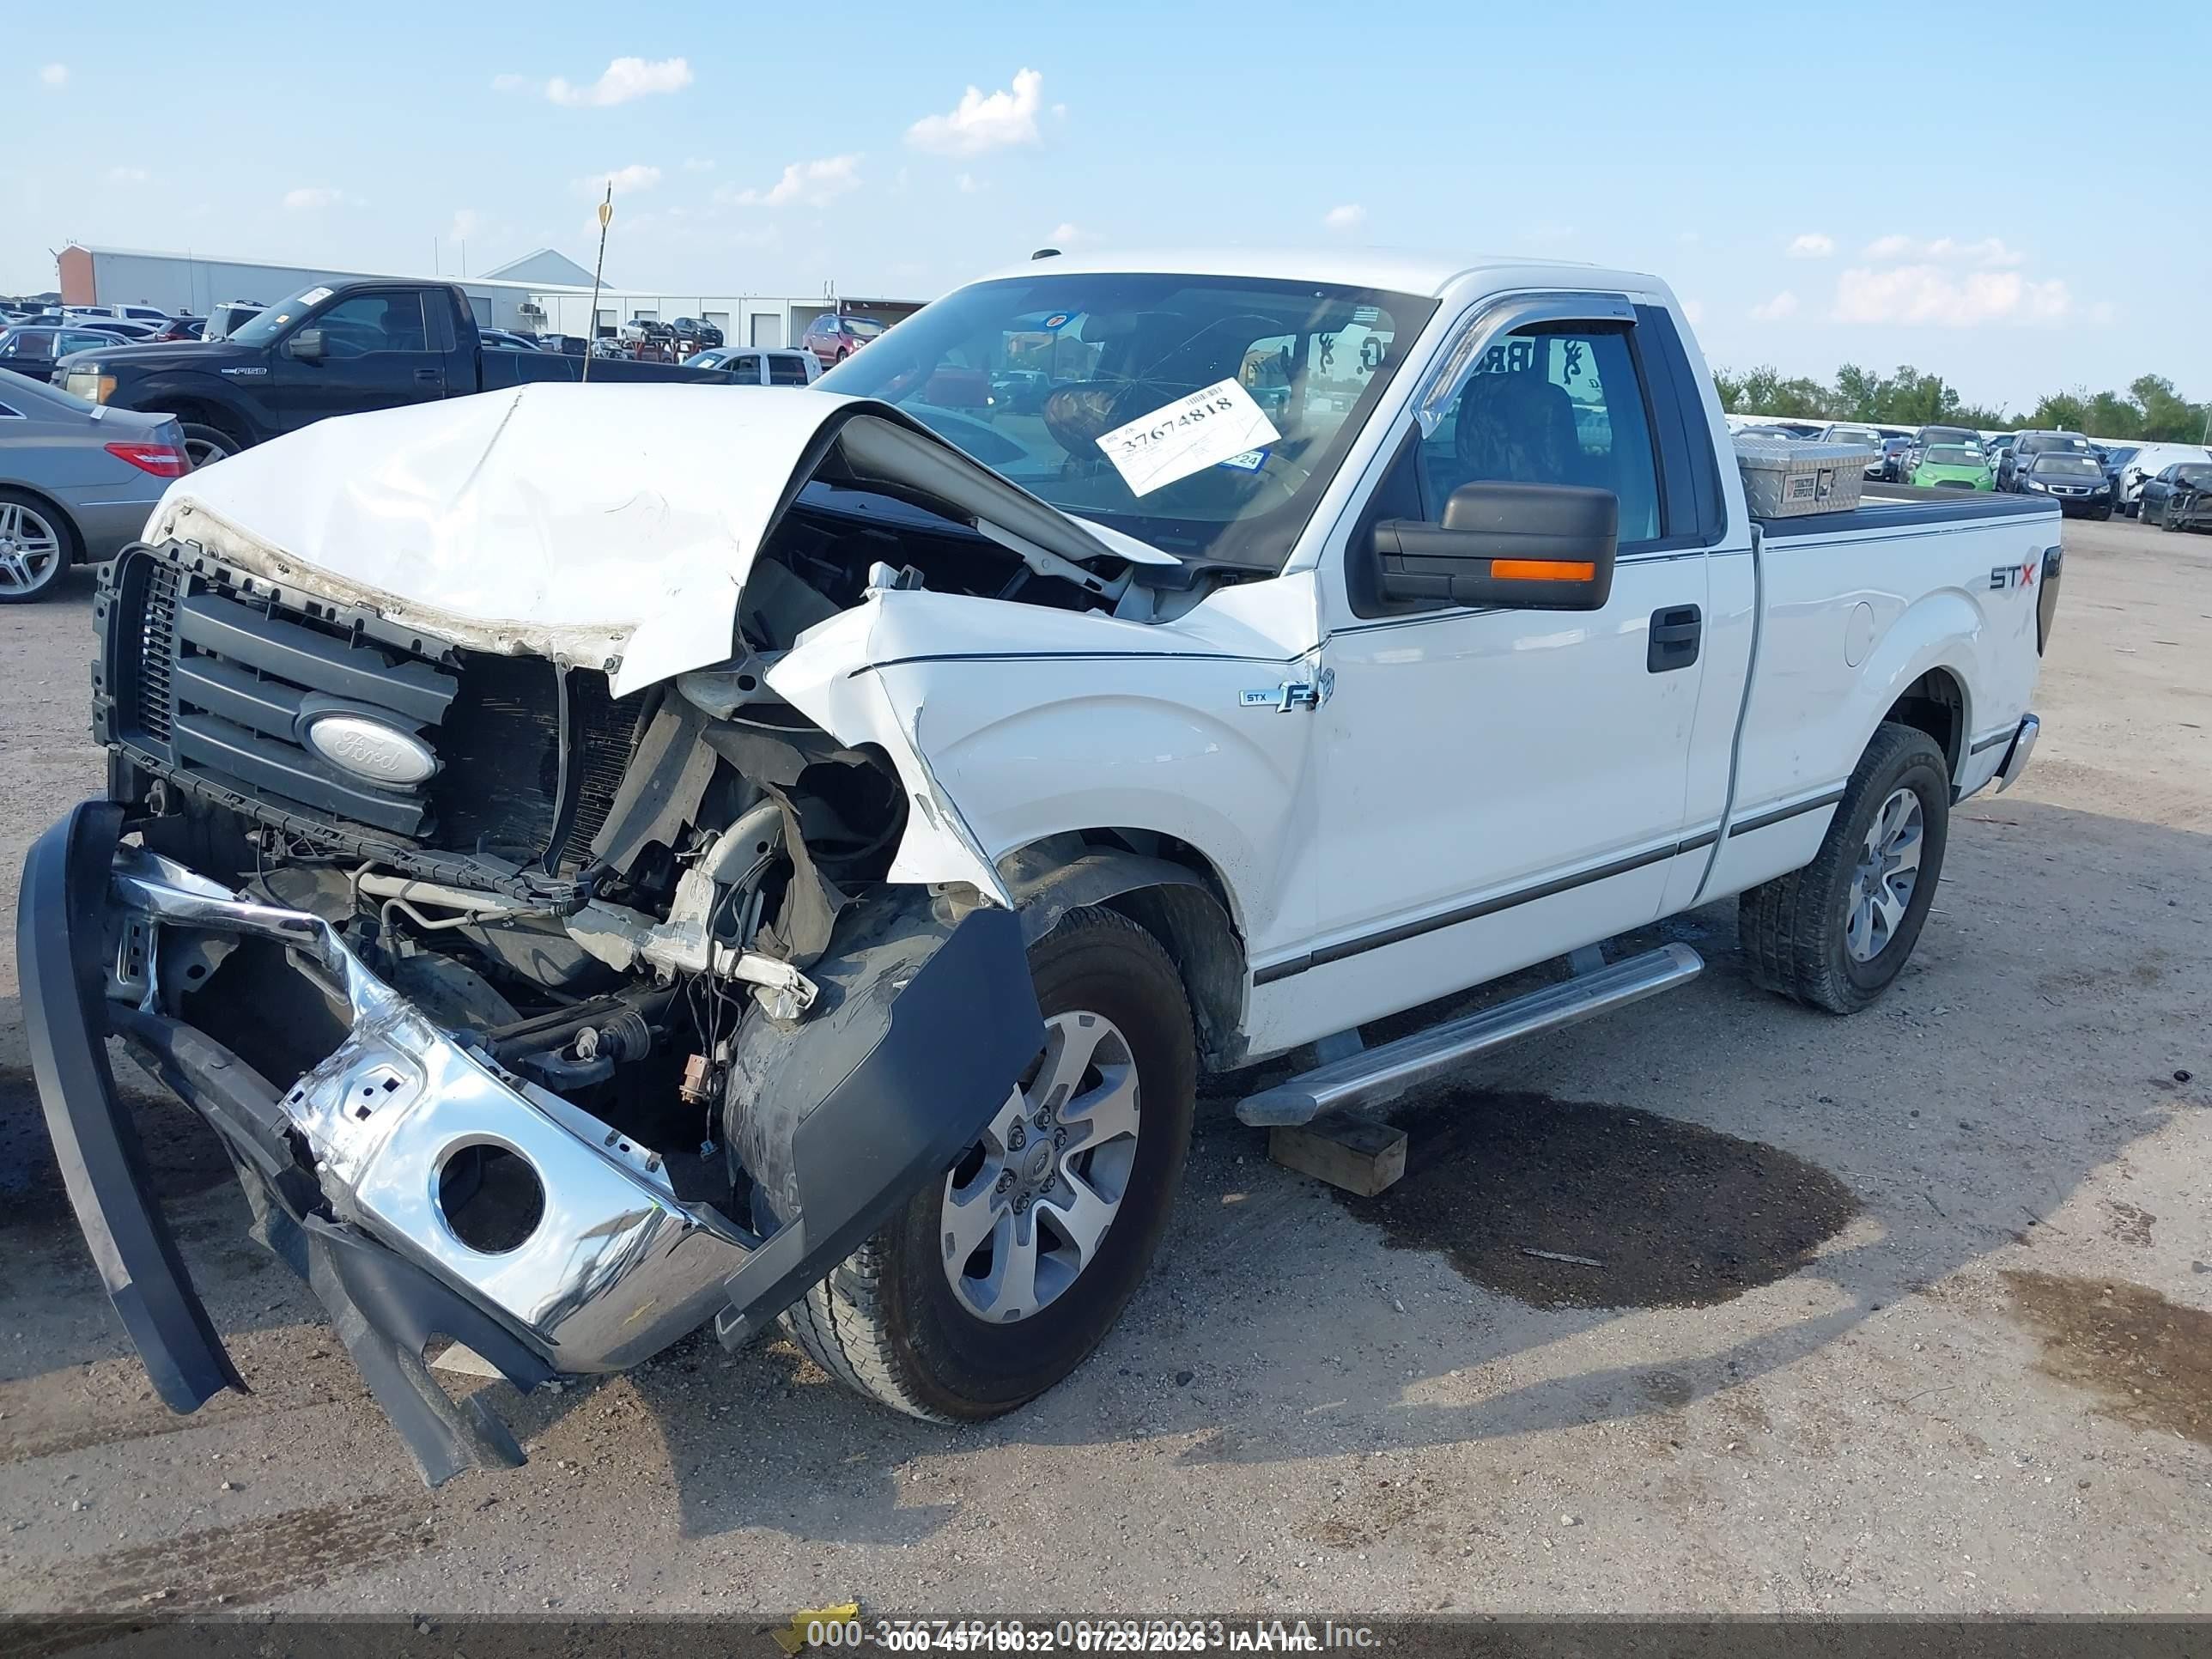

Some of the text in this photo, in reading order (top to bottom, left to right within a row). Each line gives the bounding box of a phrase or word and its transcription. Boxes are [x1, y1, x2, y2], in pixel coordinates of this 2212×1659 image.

[1121, 397, 1232, 452] 37674818
[1239, 454, 1258, 465] 24
[1990, 563, 2036, 590] STX
[1247, 693, 1267, 702] STX
[335, 731, 399, 771] Ford
